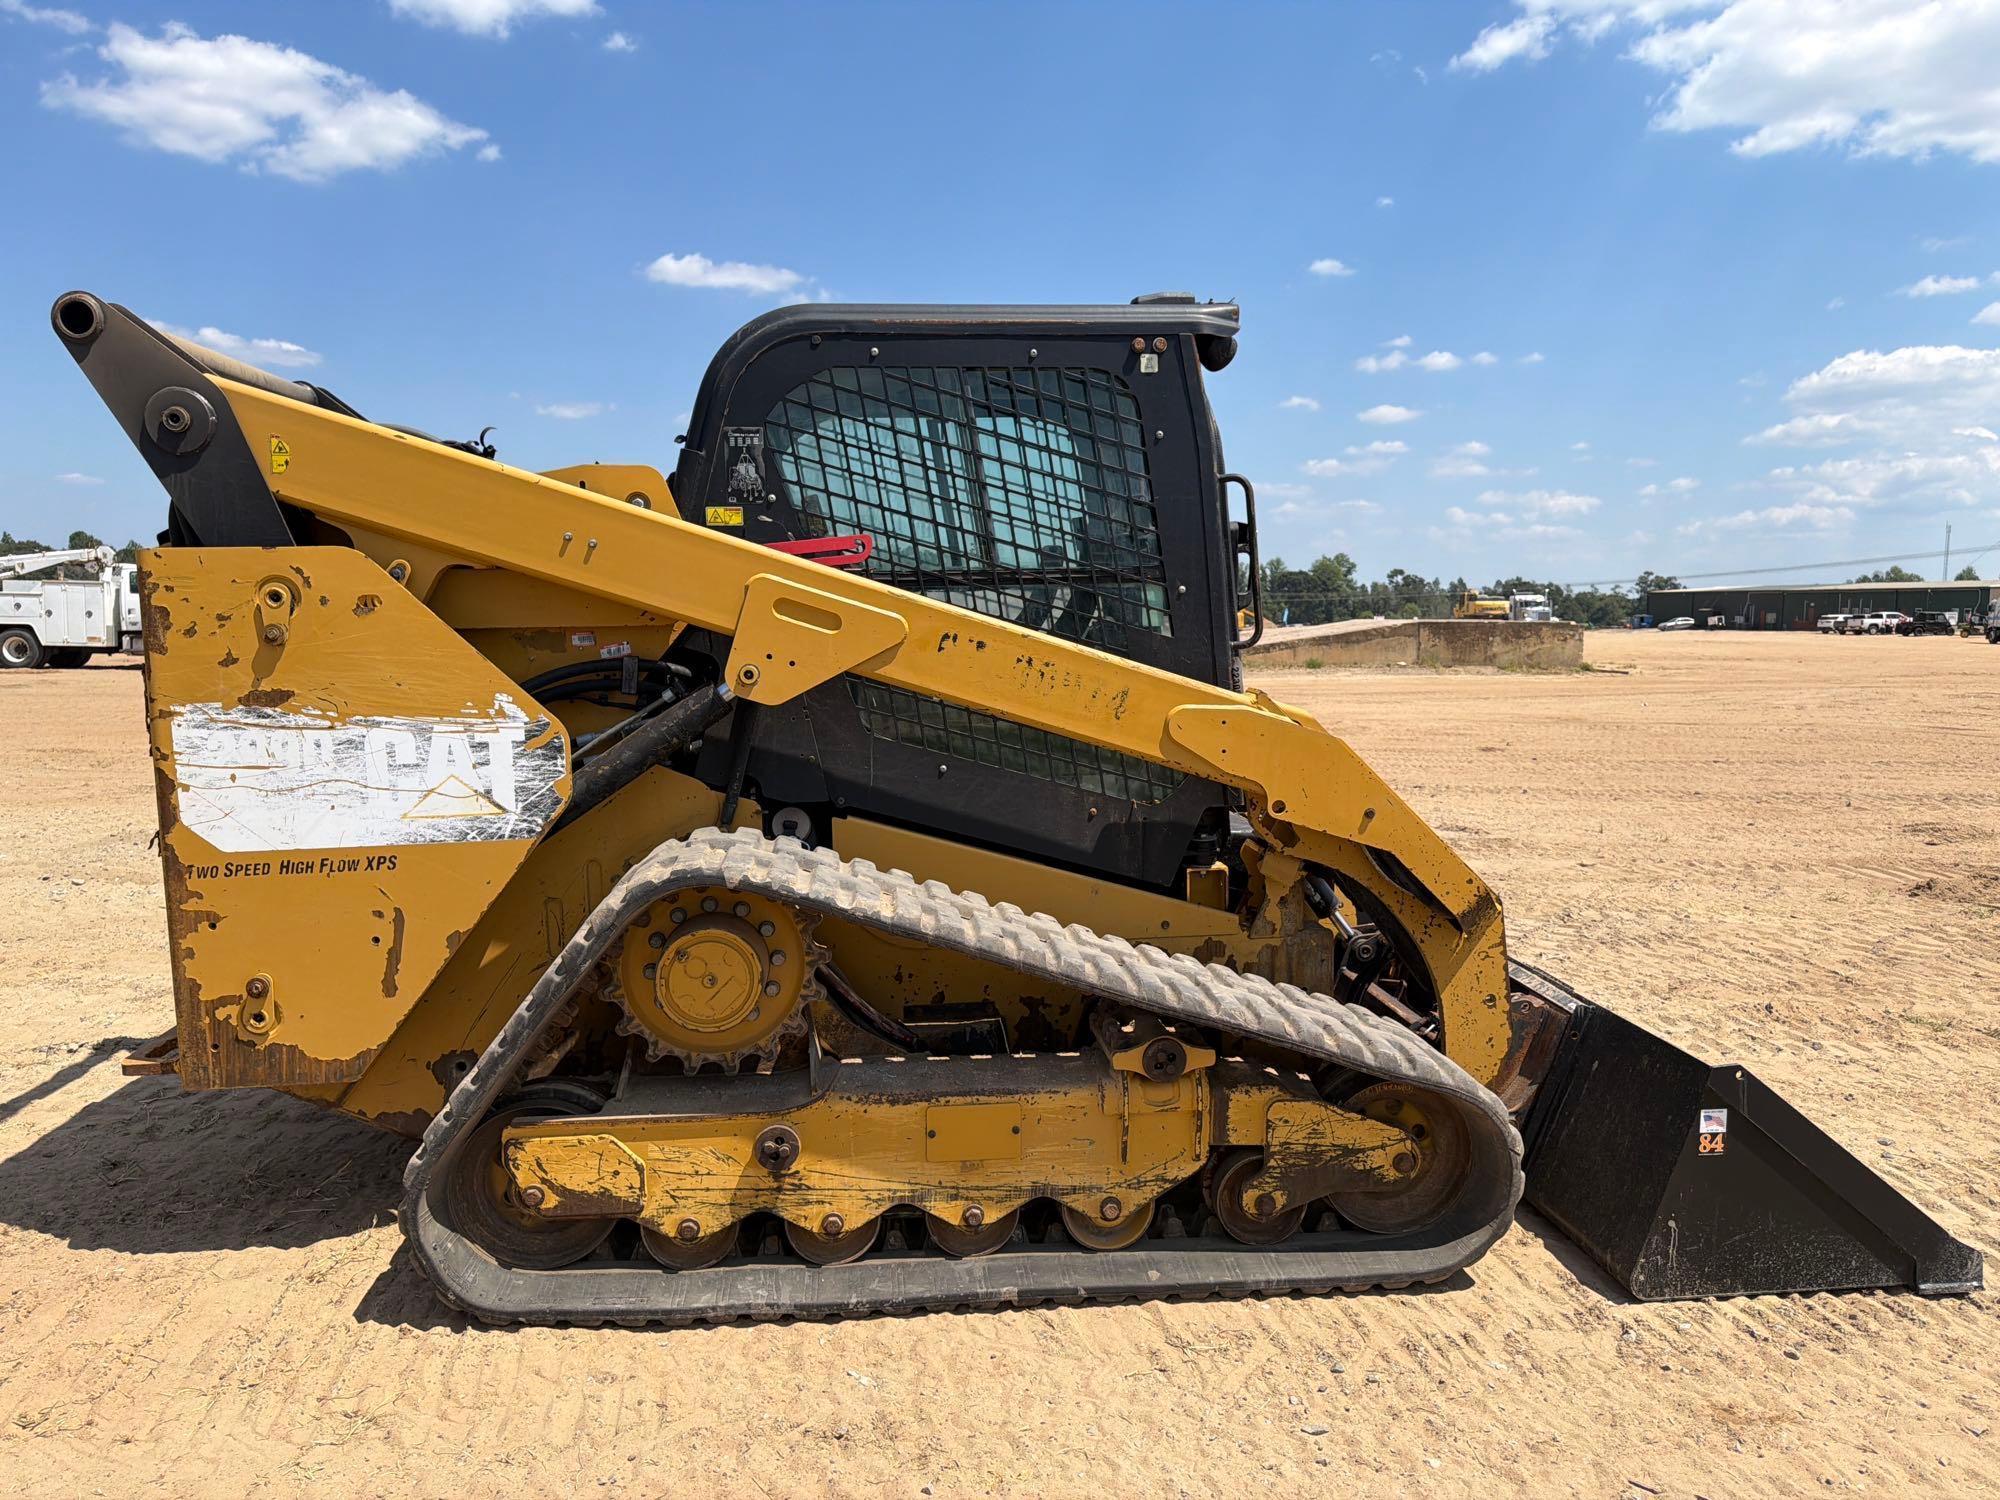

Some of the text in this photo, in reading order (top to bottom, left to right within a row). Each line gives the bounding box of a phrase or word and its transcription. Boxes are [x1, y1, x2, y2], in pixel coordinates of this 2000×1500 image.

[363, 723, 526, 812] CAT
[223, 861, 271, 878] SPEED
[279, 859, 315, 875] HIGH
[319, 857, 360, 874] FLOW
[364, 855, 398, 871] XPS
[1698, 1133, 1725, 1153] 84
